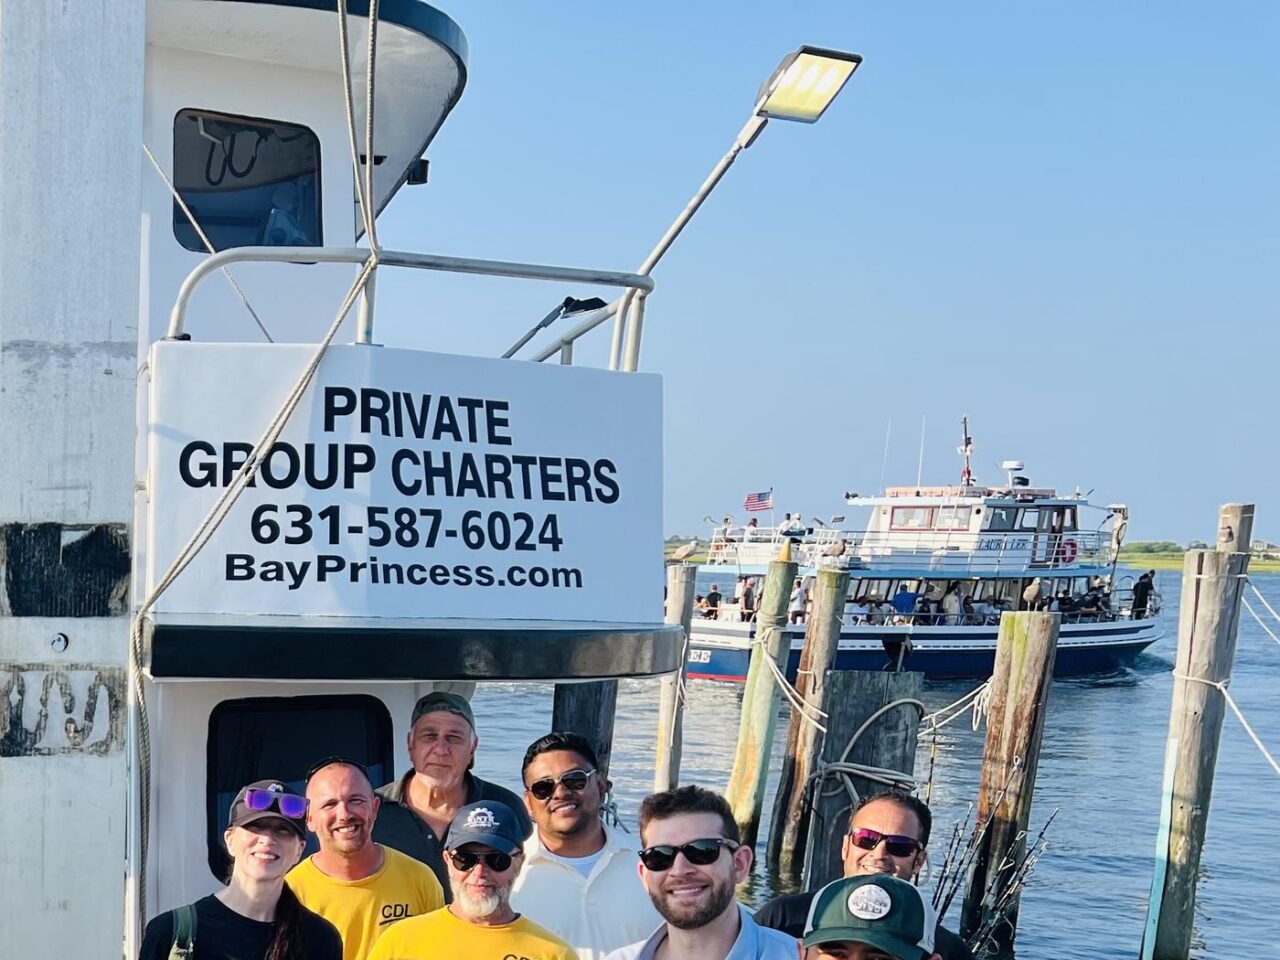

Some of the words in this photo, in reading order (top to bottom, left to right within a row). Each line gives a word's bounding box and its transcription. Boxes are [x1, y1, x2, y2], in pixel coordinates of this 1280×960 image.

[324, 386, 512, 446] PRIVATE
[179, 440, 377, 490] GROUP
[391, 447, 620, 504] CHARTERS
[251, 503, 564, 553] 631-587-6024
[224, 553, 583, 591] BayPrincess.com
[381, 903, 417, 919] CDL
